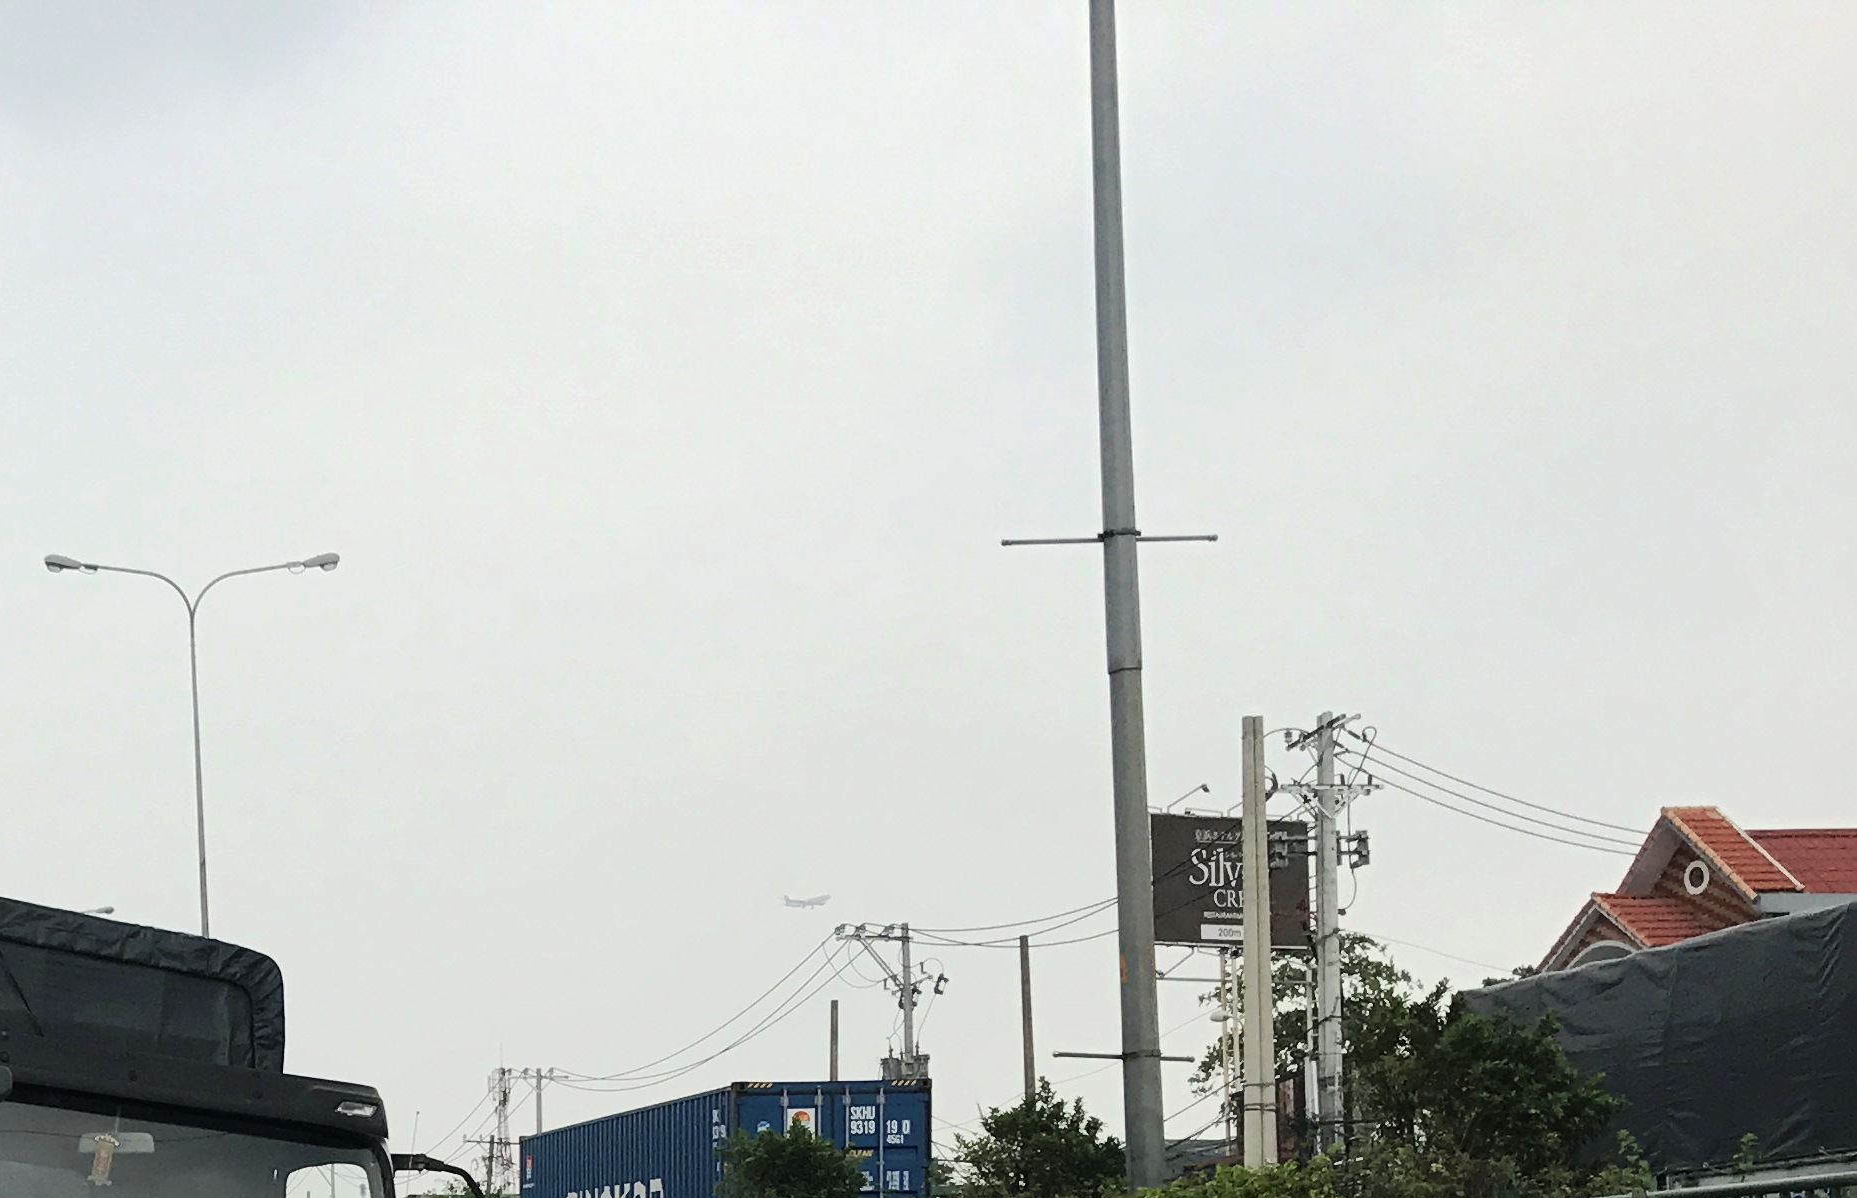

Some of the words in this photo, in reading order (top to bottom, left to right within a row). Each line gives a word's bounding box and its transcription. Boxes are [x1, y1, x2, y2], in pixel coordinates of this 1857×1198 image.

[1189, 848, 1243, 887] Silv
[850, 1105, 876, 1120] SKHU
[850, 1120, 876, 1135] 9319
